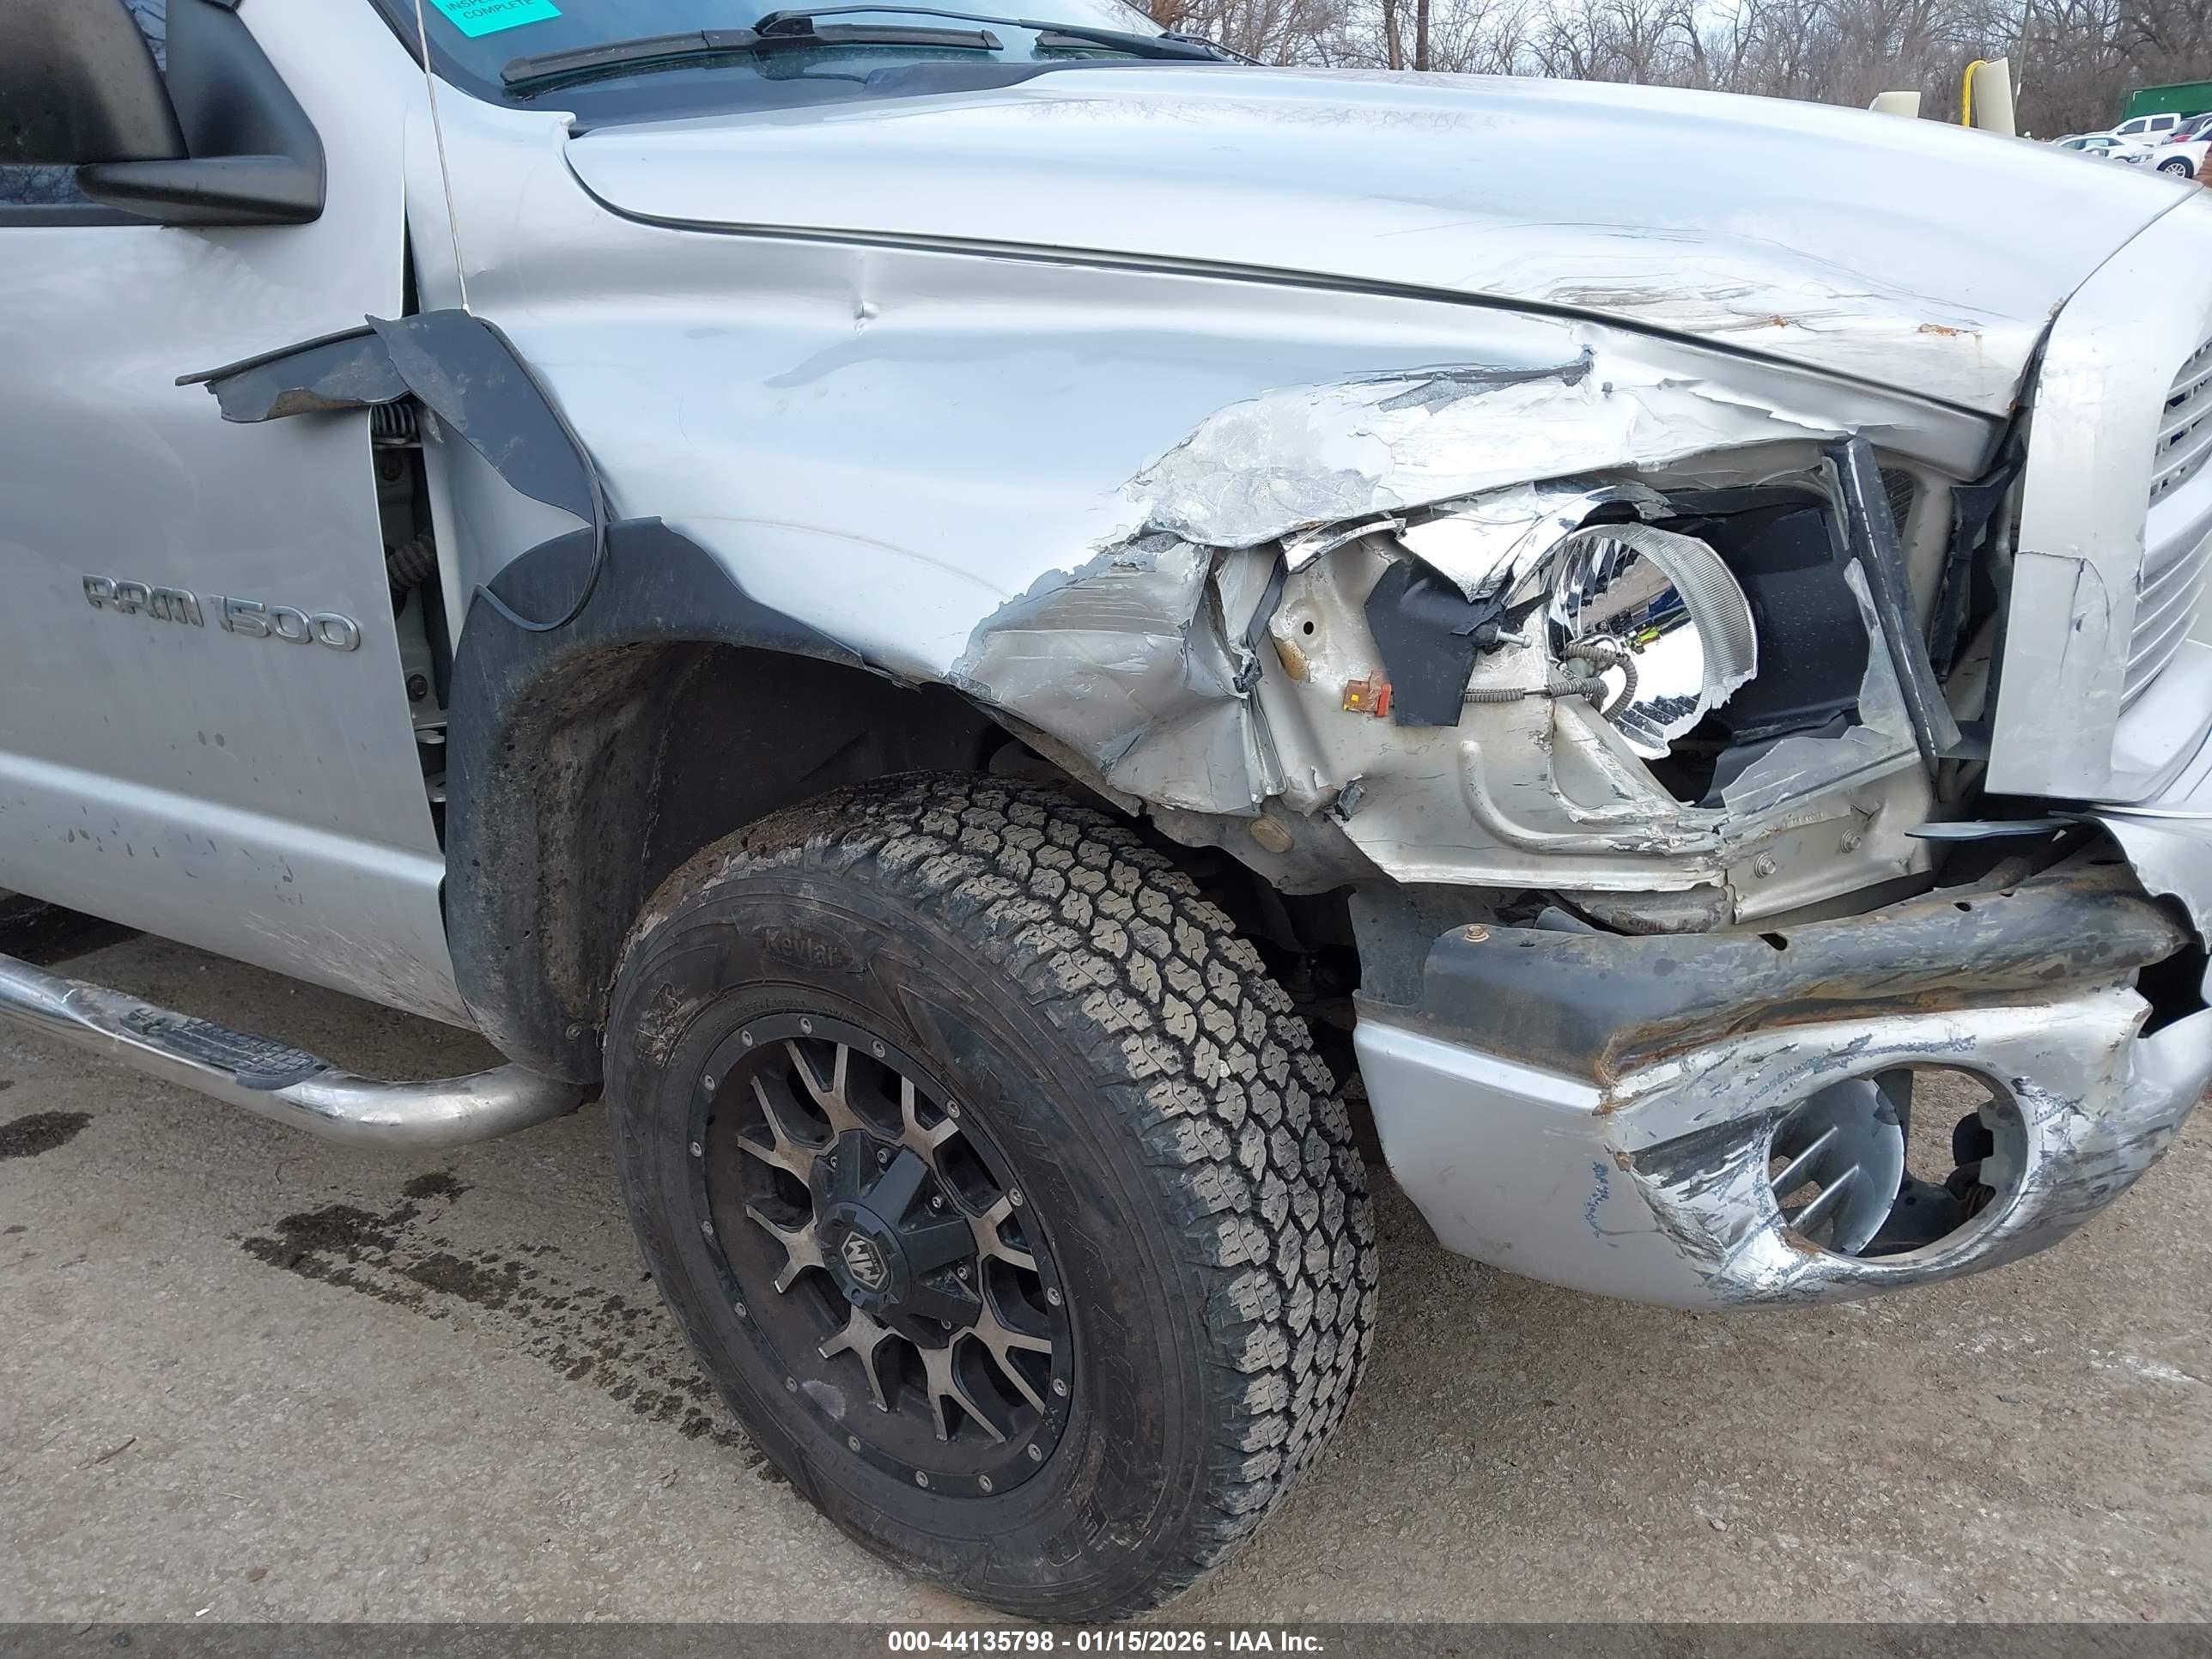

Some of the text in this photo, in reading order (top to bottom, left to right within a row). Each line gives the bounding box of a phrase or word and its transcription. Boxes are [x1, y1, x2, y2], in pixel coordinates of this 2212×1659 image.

[462, 0, 536, 19] COMPLETE
[82, 574, 361, 652] RAM 1500
[764, 927, 839, 966] Kevlar
